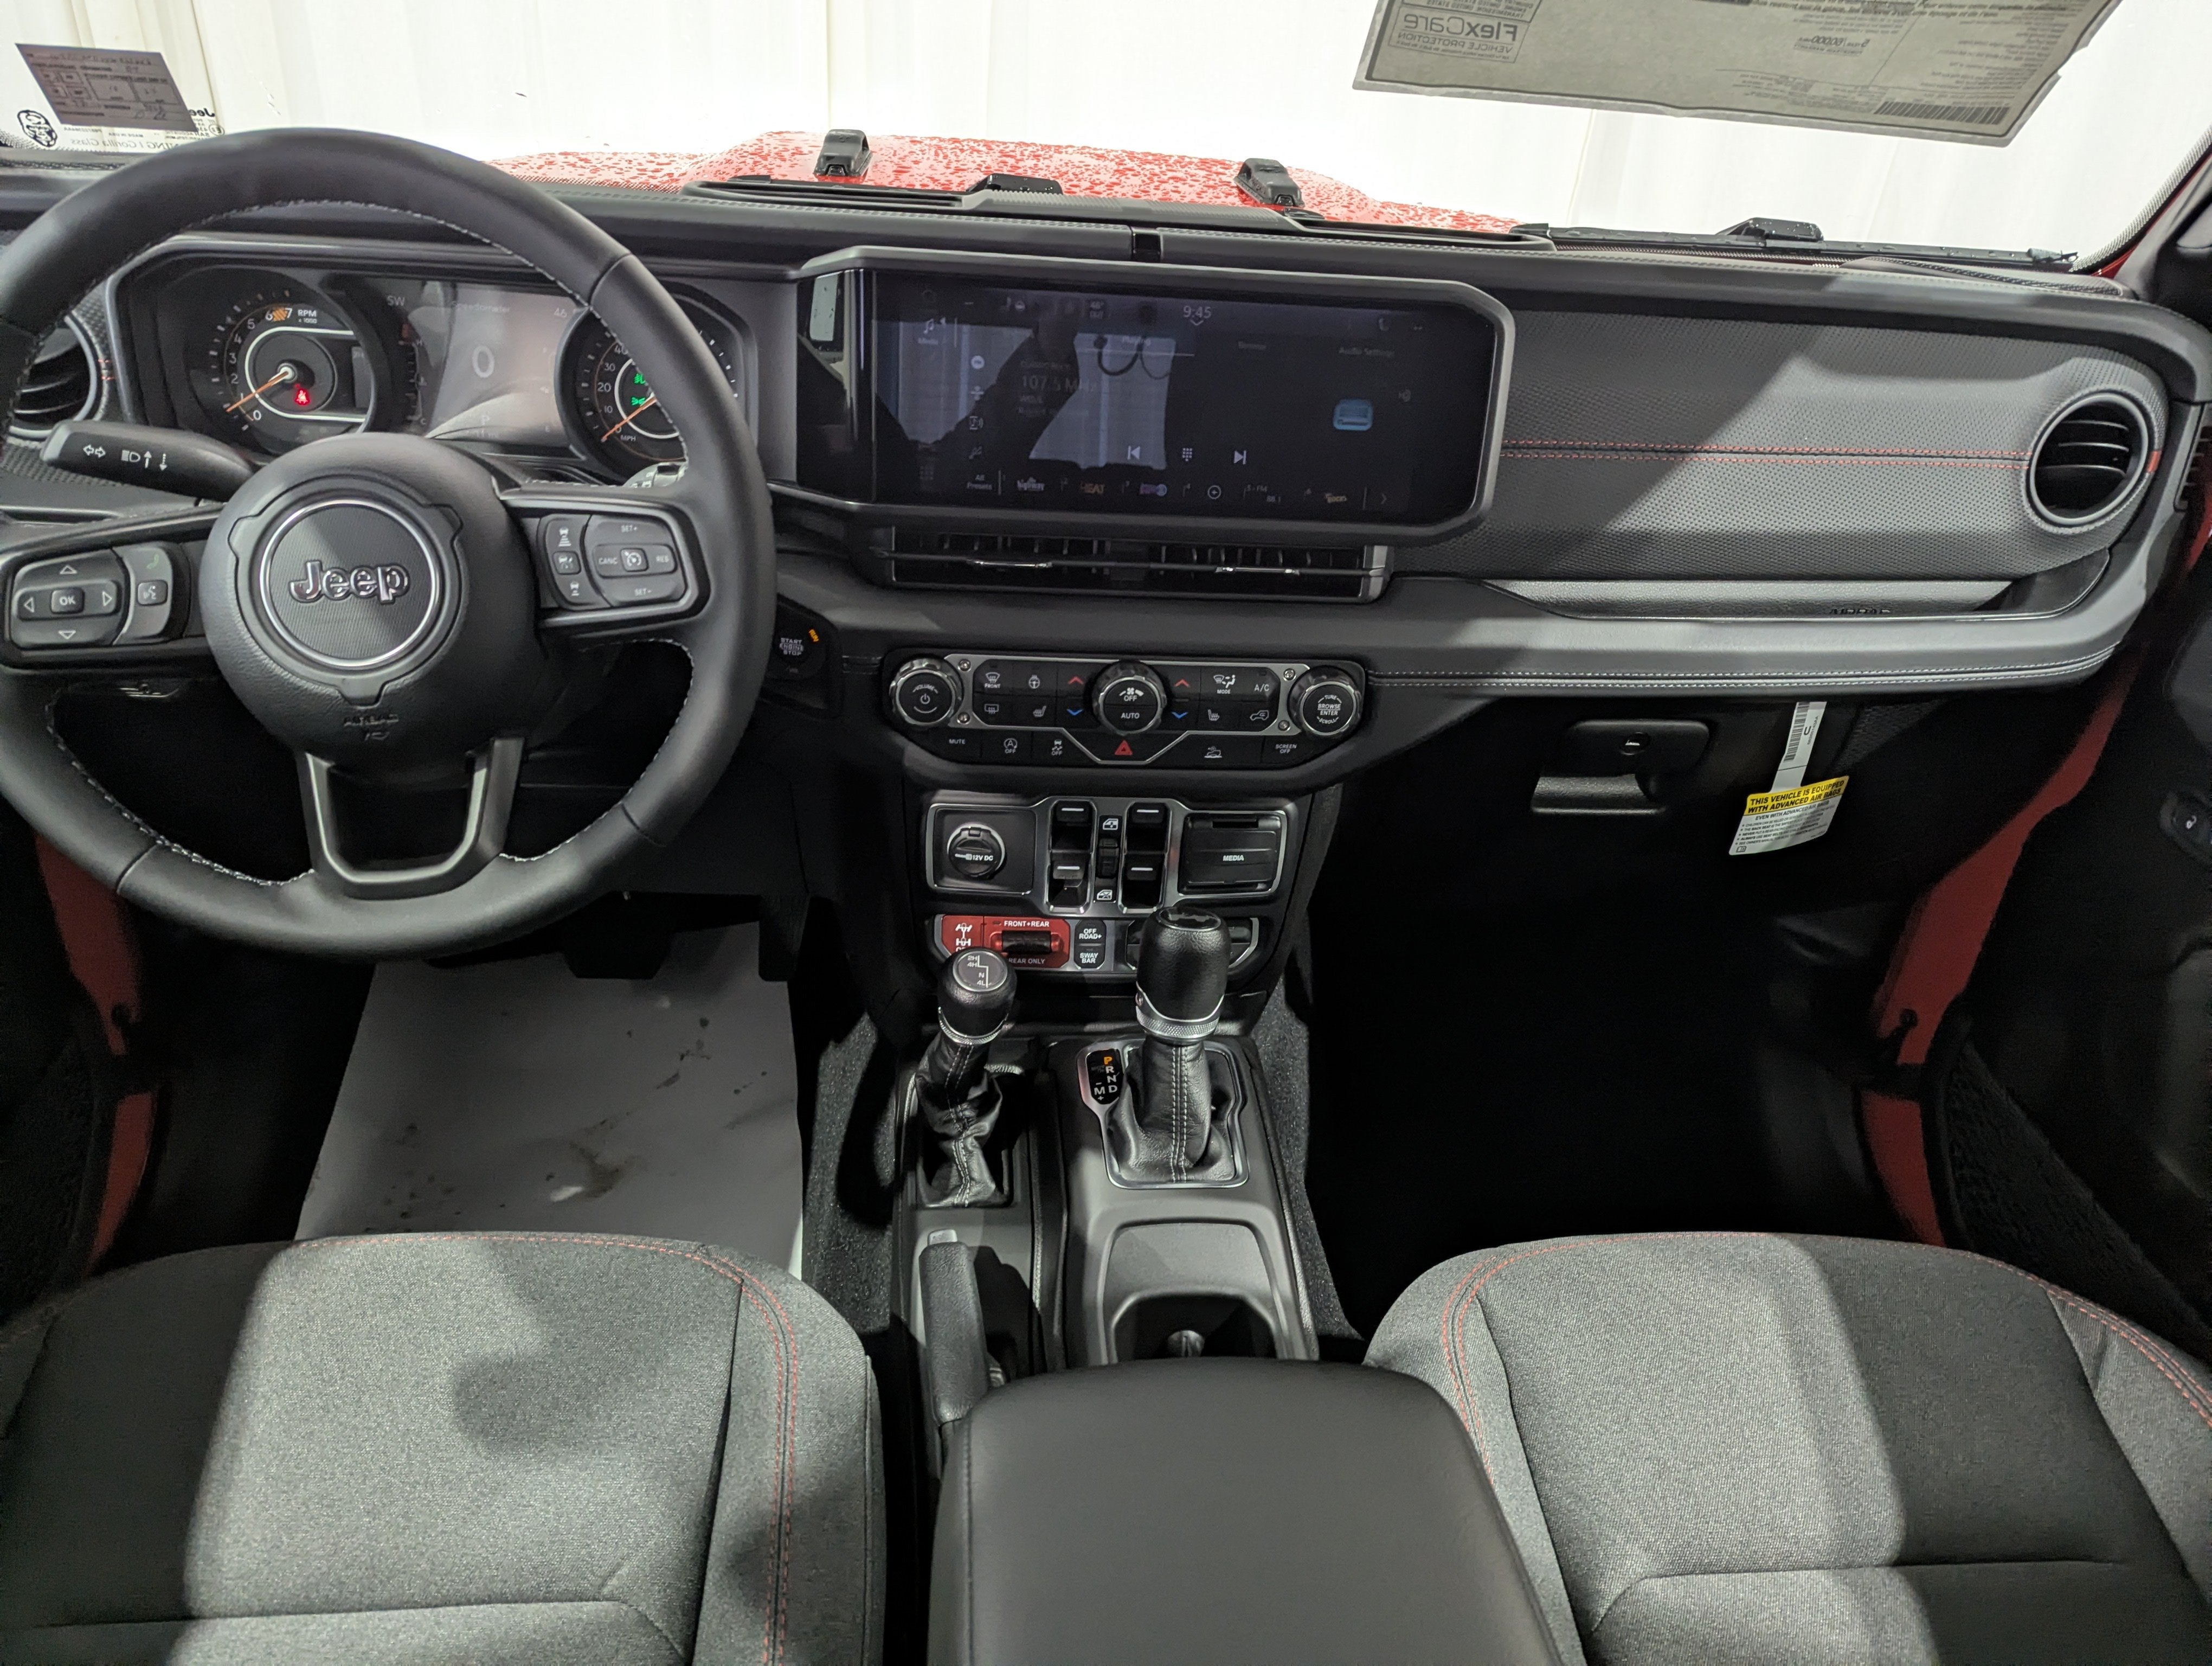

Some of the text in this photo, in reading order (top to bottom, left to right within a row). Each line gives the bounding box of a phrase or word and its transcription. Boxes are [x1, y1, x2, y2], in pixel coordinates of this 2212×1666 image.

[265, 311, 273, 321] 6
[286, 308, 293, 318] 7
[298, 309, 317, 318] RPM
[1182, 305, 1212, 318] 9:45
[248, 320, 255, 330] 5
[234, 334, 242, 344] 4
[229, 353, 237, 364] 3
[472, 347, 495, 379] 0
[604, 362, 616, 372] 30
[231, 374, 239, 385] 2
[597, 382, 612, 393] 20
[604, 405, 614, 414] 10
[253, 410, 262, 420] 0
[289, 560, 410, 604] Jeep
[59, 595, 76, 606] OK
[1254, 683, 1270, 693] A/C
[1750, 798, 1769, 806] THIS
[1771, 791, 1802, 803] VEHICLE
[1811, 780, 1844, 794] EQUIPPED
[1748, 805, 1768, 813] WITH
[1769, 797, 1809, 811] ADVANCED
[1823, 789, 1842, 798] BAGS
[1783, 806, 1809, 816] ADVANCED
[1103, 1056, 1113, 1065] P
[1105, 1066, 1115, 1074] R
[1107, 1074, 1117, 1083] N
[1094, 1086, 1105, 1095] M
